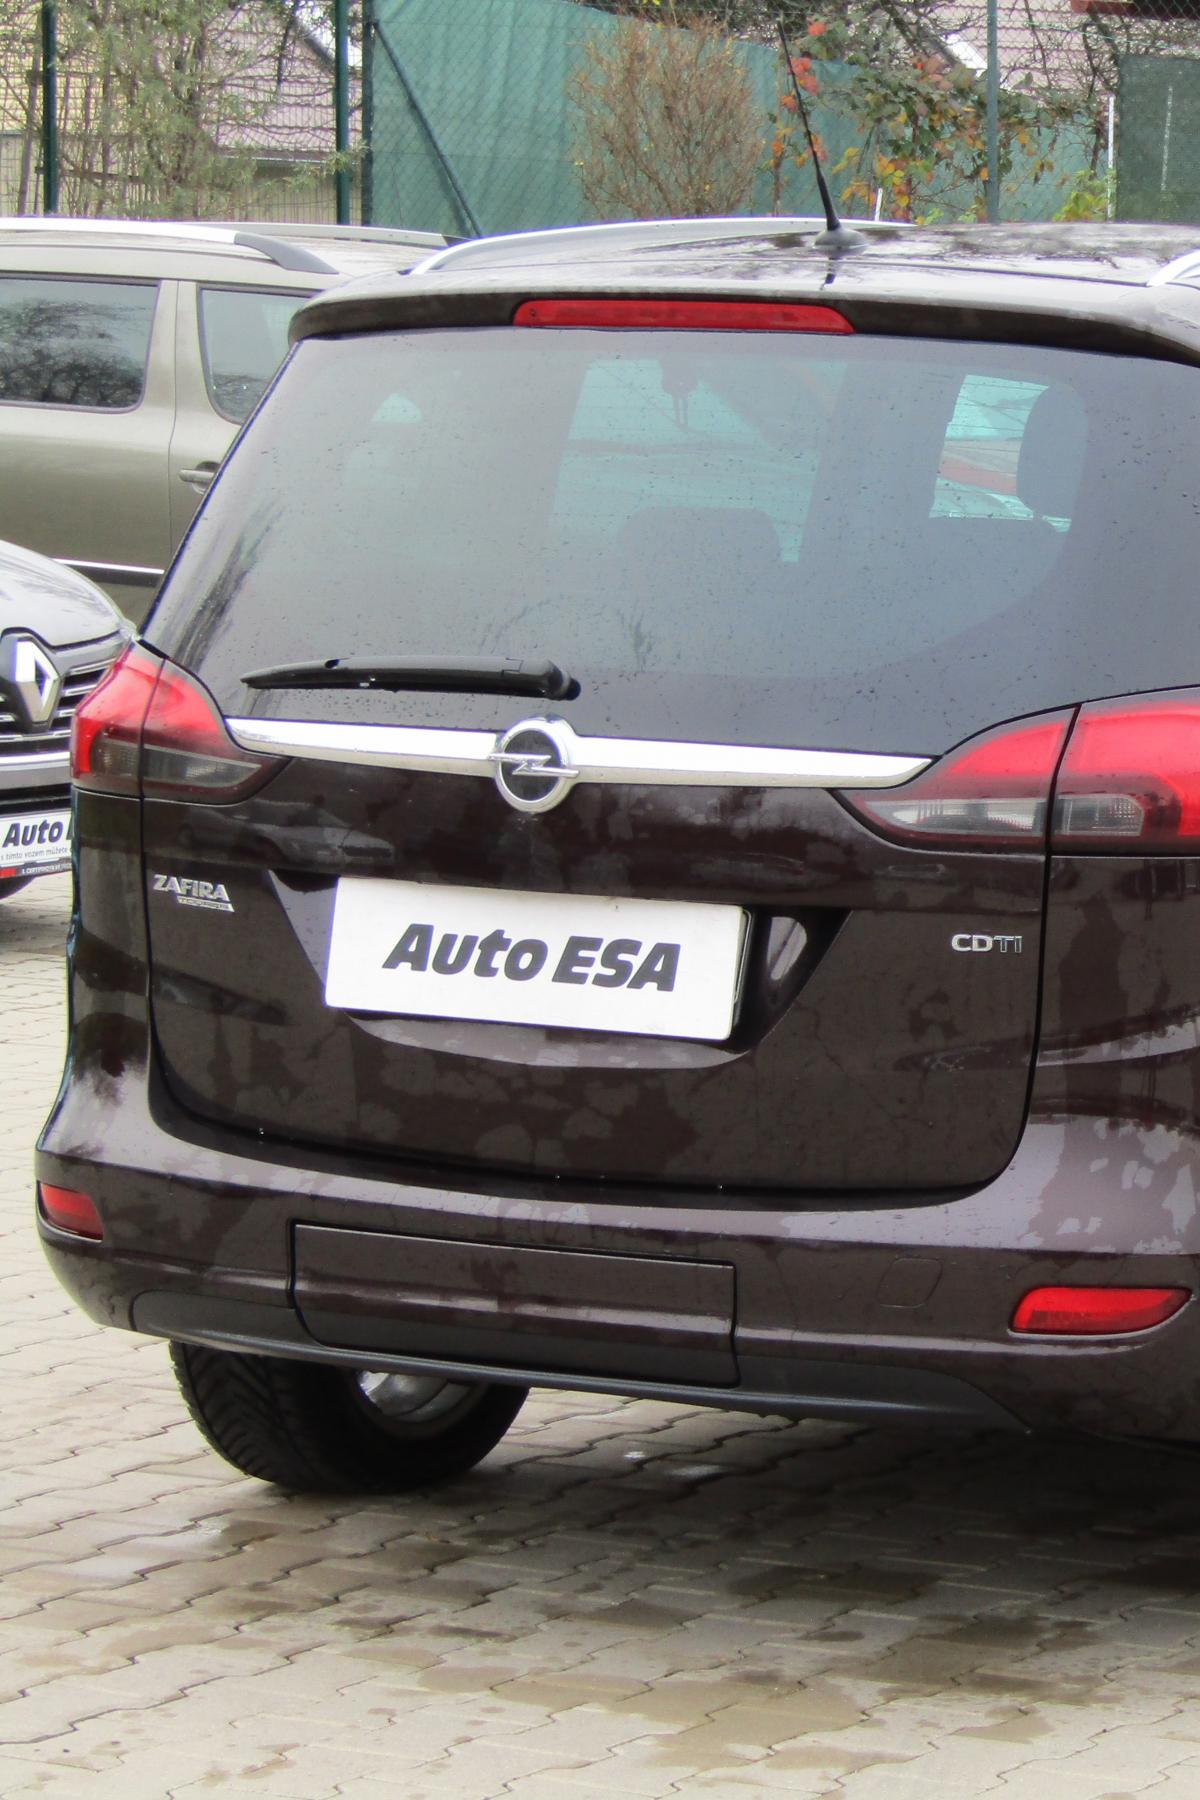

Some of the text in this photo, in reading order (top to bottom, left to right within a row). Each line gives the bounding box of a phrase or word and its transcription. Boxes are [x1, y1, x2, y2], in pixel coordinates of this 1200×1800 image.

[2, 819, 64, 848] Auto
[153, 873, 231, 902] ZAFIRA
[382, 923, 681, 992] Auto ESA
[951, 933, 1022, 953] CDTI
